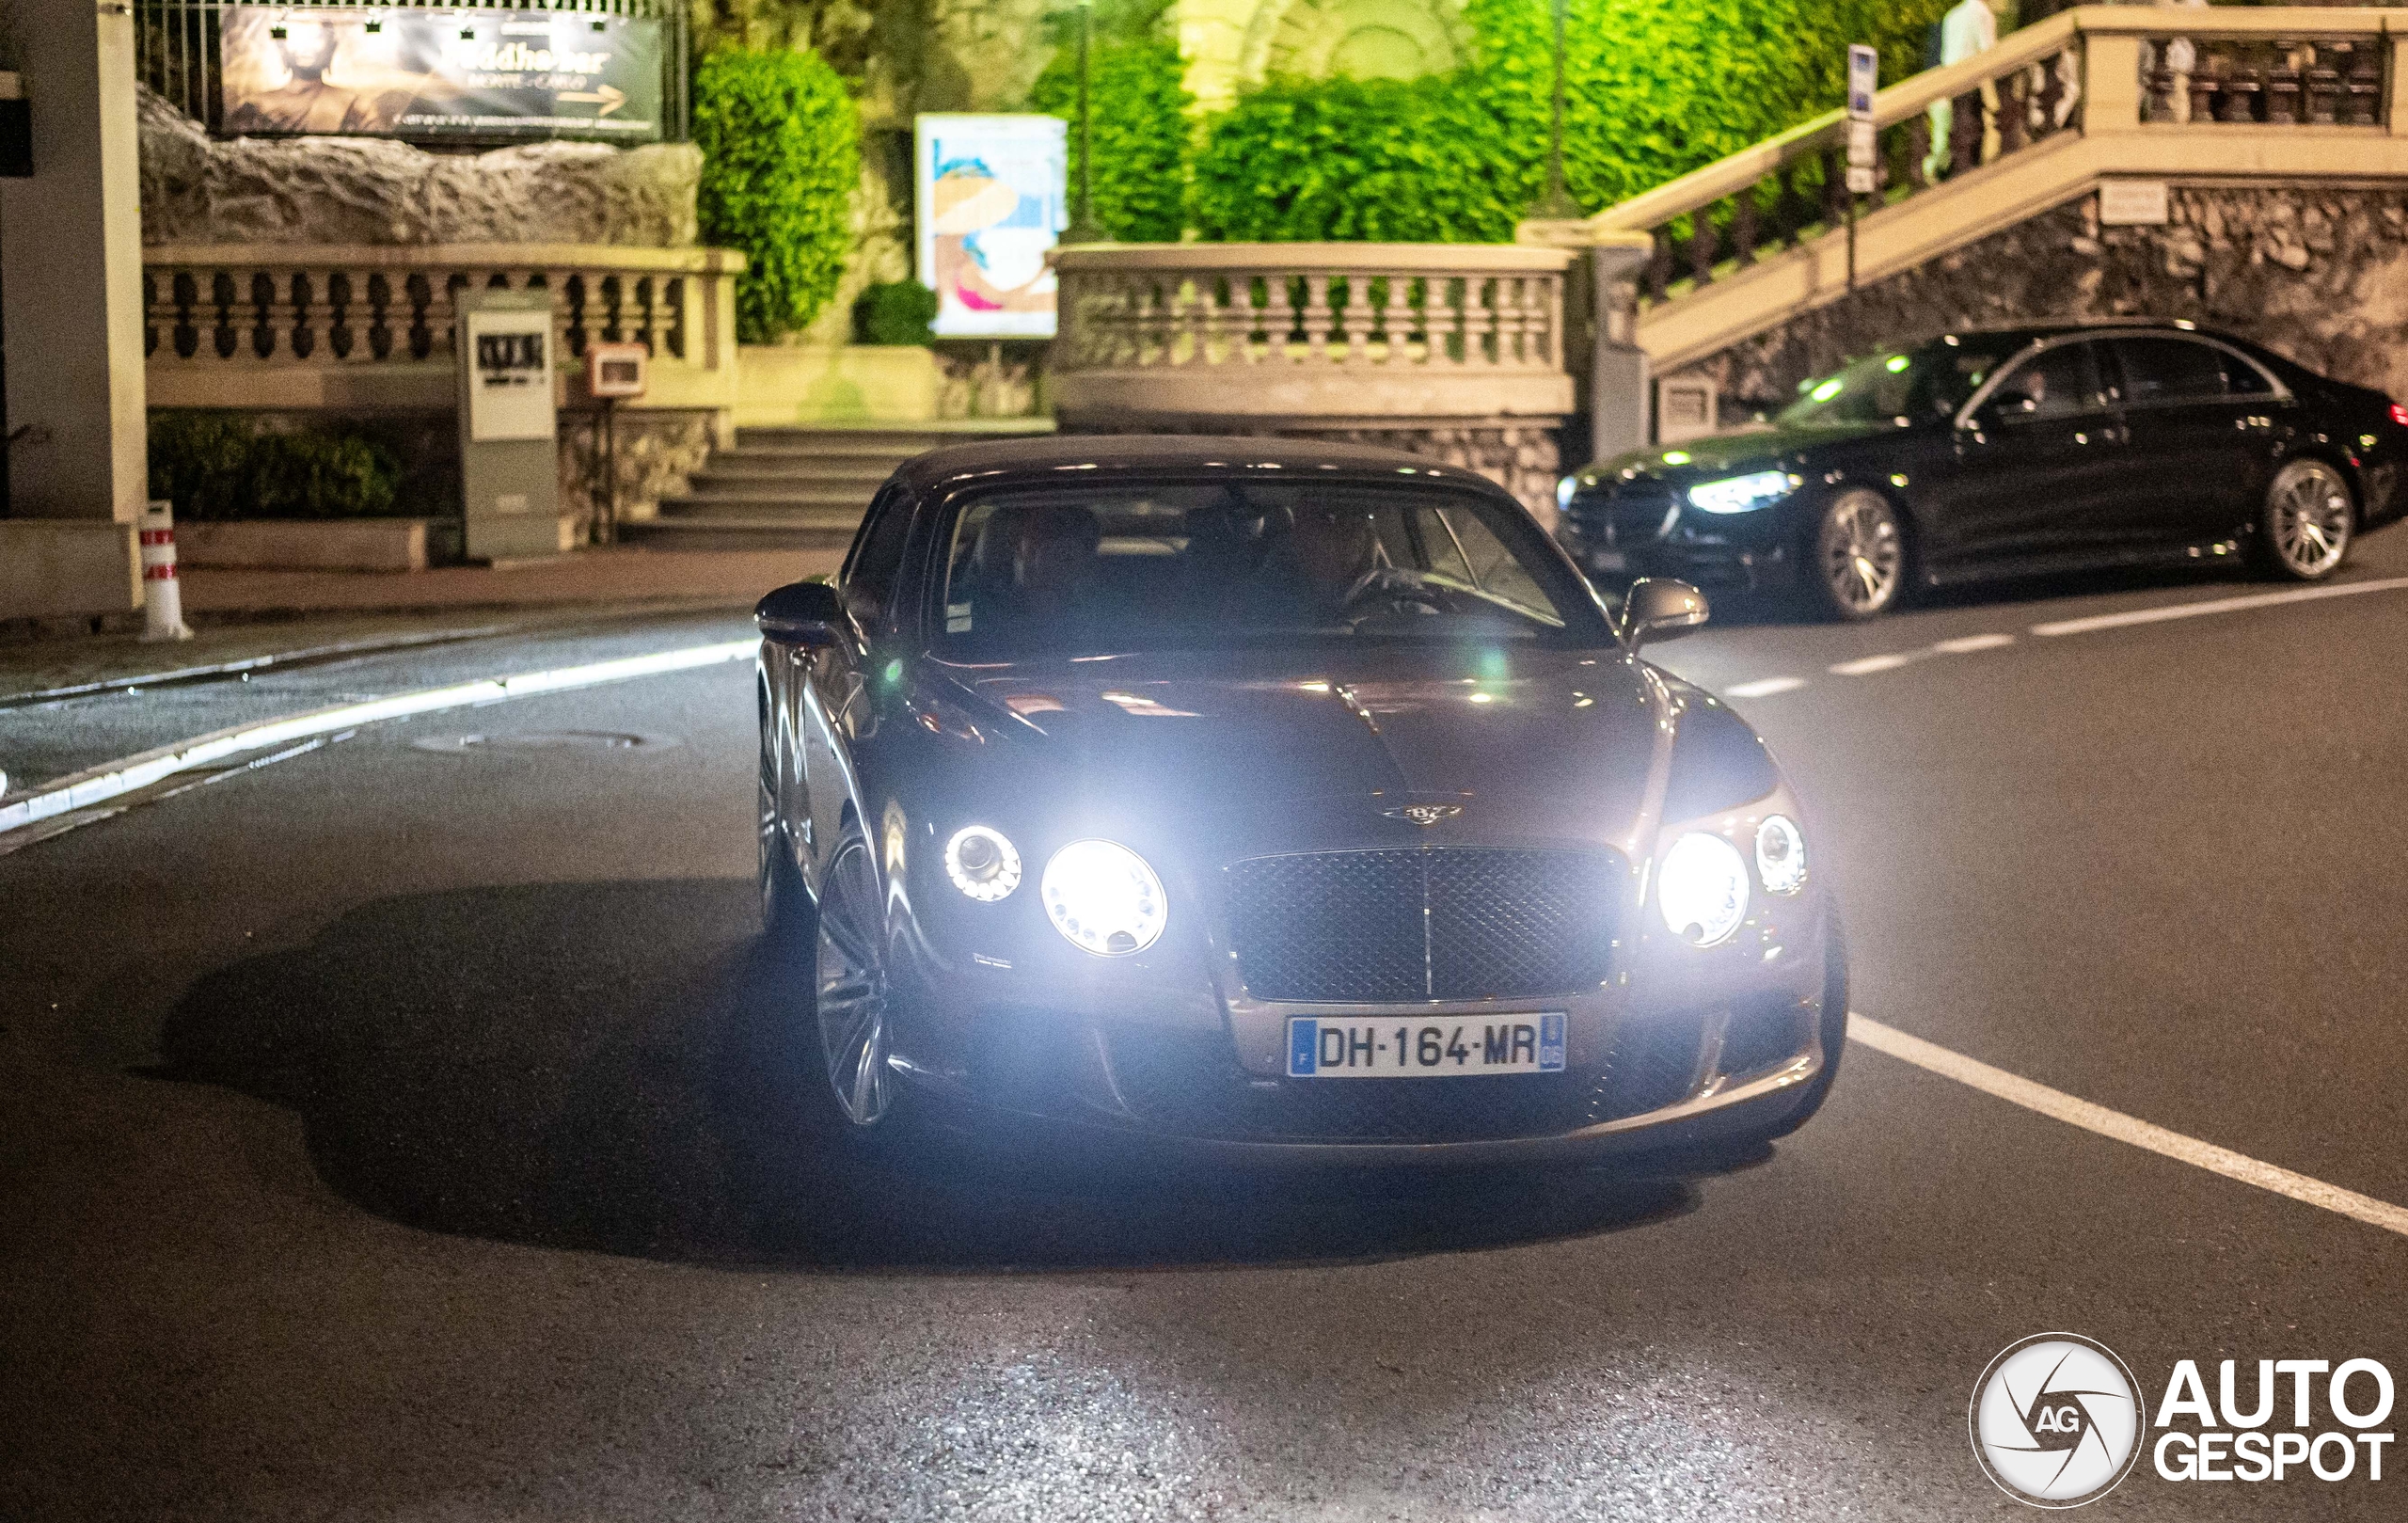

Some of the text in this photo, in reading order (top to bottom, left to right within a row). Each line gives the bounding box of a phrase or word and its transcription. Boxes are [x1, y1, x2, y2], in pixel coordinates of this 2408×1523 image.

[440, 41, 610, 74] ddha-bar
[1299, 1053, 1307, 1066] F
[1320, 1024, 1535, 1068] DH-164-MR
